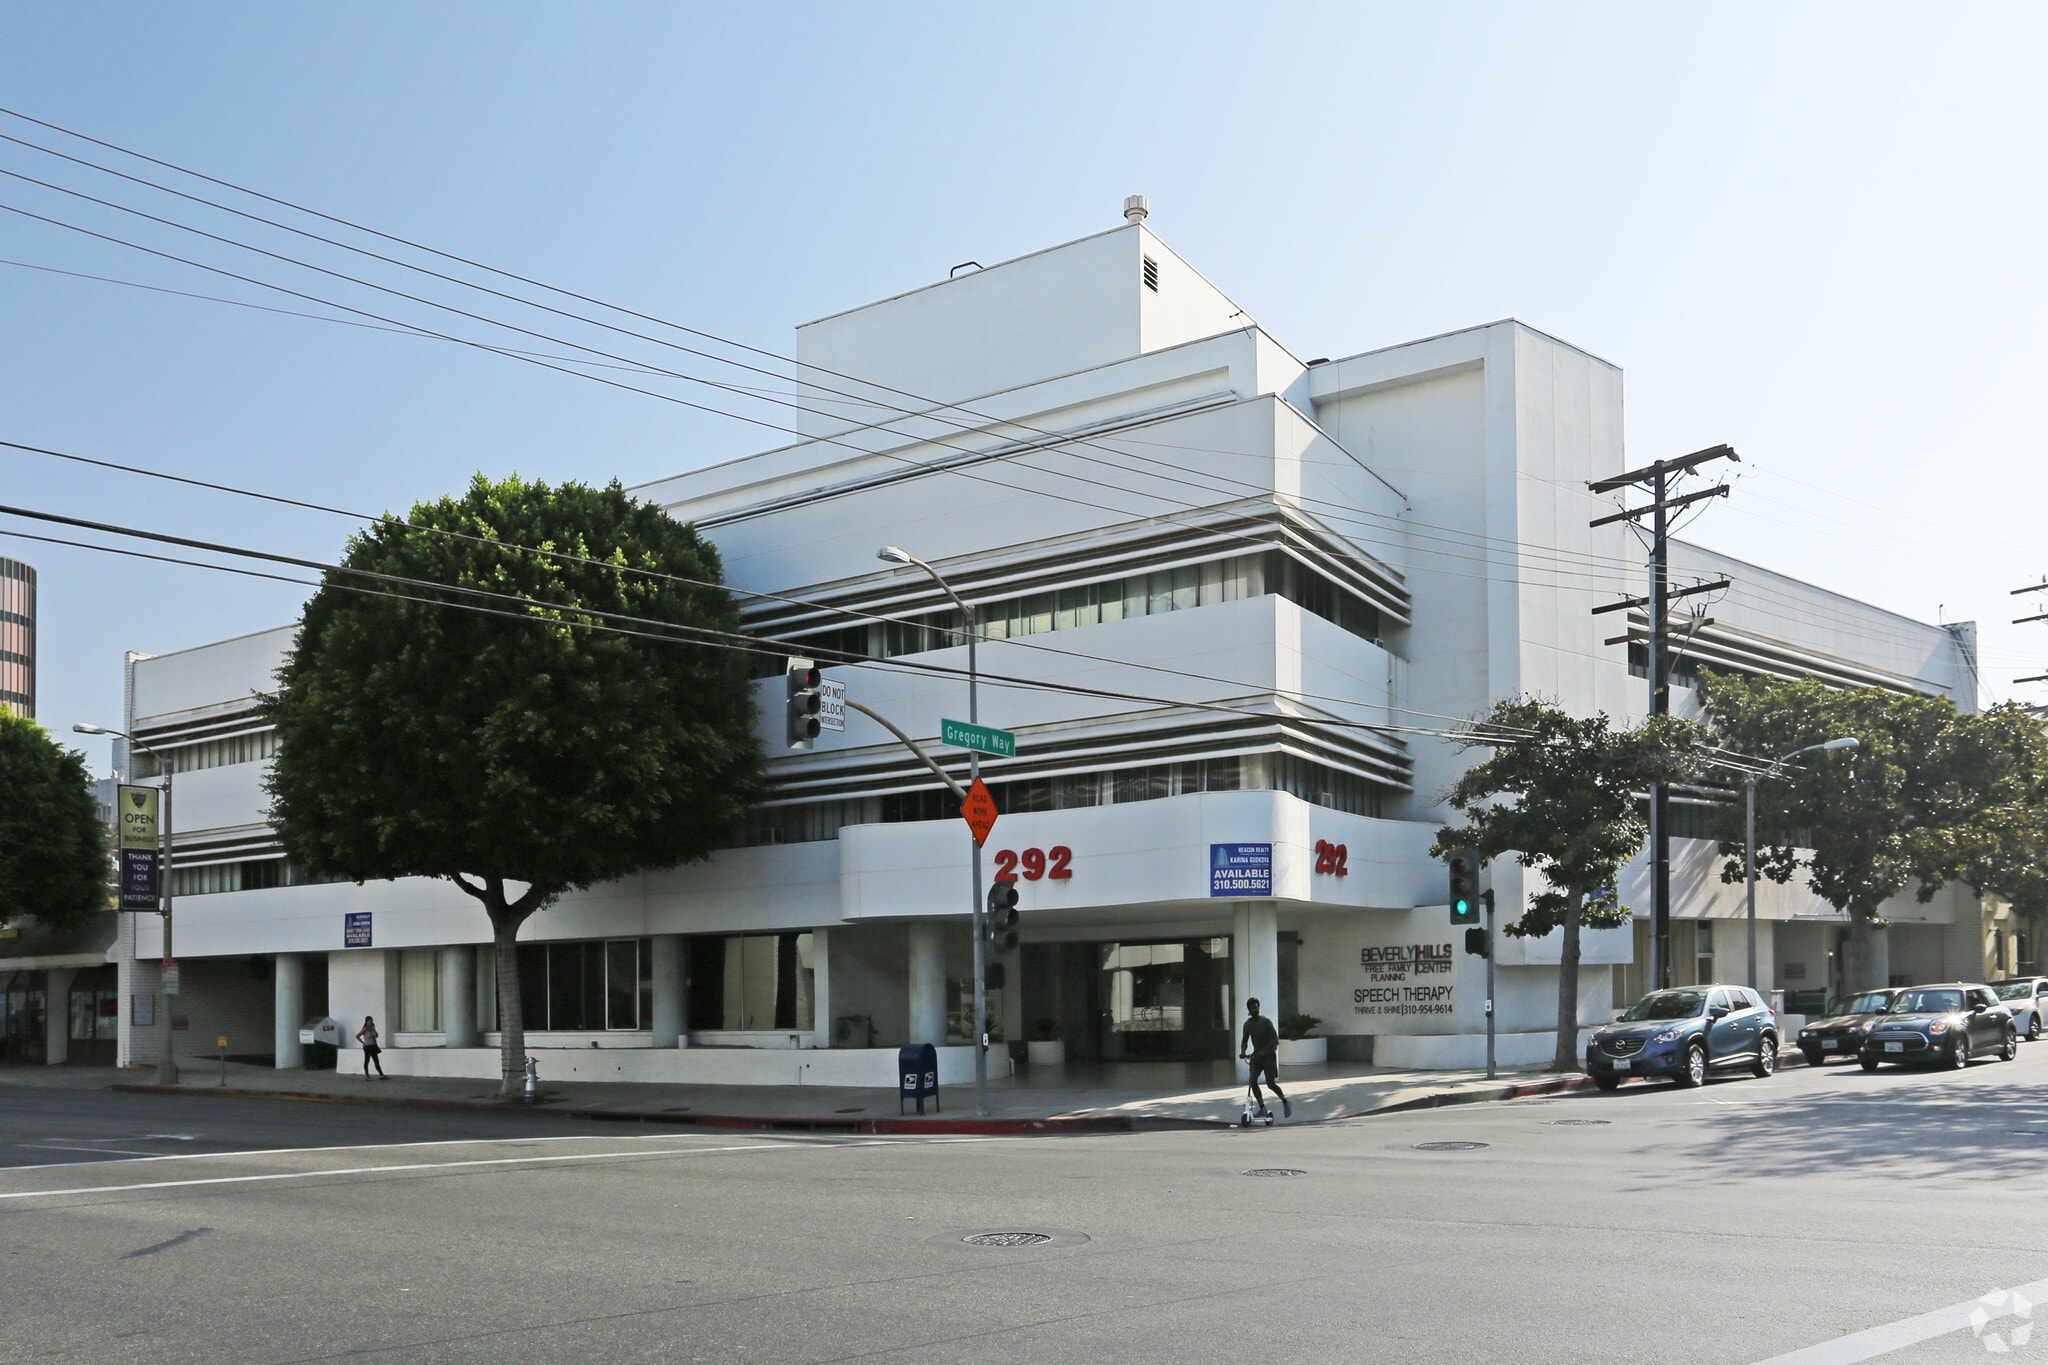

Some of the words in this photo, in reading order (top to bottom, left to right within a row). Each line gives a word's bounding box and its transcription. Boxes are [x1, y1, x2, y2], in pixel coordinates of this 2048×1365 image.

[822, 684, 831, 697] DO
[832, 688, 844, 700] NOT
[822, 701, 844, 717] BLOCK
[947, 726, 987, 749] Gregory
[992, 734, 1010, 753] Way
[972, 794, 988, 803] ROAD
[973, 807, 988, 816] WORK
[124, 813, 154, 825] OPEN
[972, 820, 989, 830] AHEAD
[124, 835, 155, 843] BUSINESS
[128, 853, 152, 861] THANK
[1315, 839, 1348, 877] 292
[132, 863, 149, 871] YOU
[994, 845, 1073, 882] 292
[133, 873, 148, 881] FOR
[1214, 869, 1270, 879] AVAILABLE
[1214, 879, 1270, 890] 310.500.5621
[124, 894, 156, 902] PATIENCE
[1361, 946, 1415, 962] BEVERLY
[1417, 943, 1452, 960] HILLS
[1365, 964, 1385, 974] FREE
[1388, 963, 1412, 973] FAMILY
[1417, 963, 1451, 974] CENTER
[1371, 973, 1406, 982] PLANNING
[1354, 987, 1400, 1003] SPEECH
[1403, 985, 1454, 1001] THERAPY
[1355, 1006, 1376, 1015] THRIVE
[1377, 1006, 1382, 1014] &
[1383, 1005, 1401, 1014] SHINE
[1404, 1004, 1453, 1015] 310-954-9614
